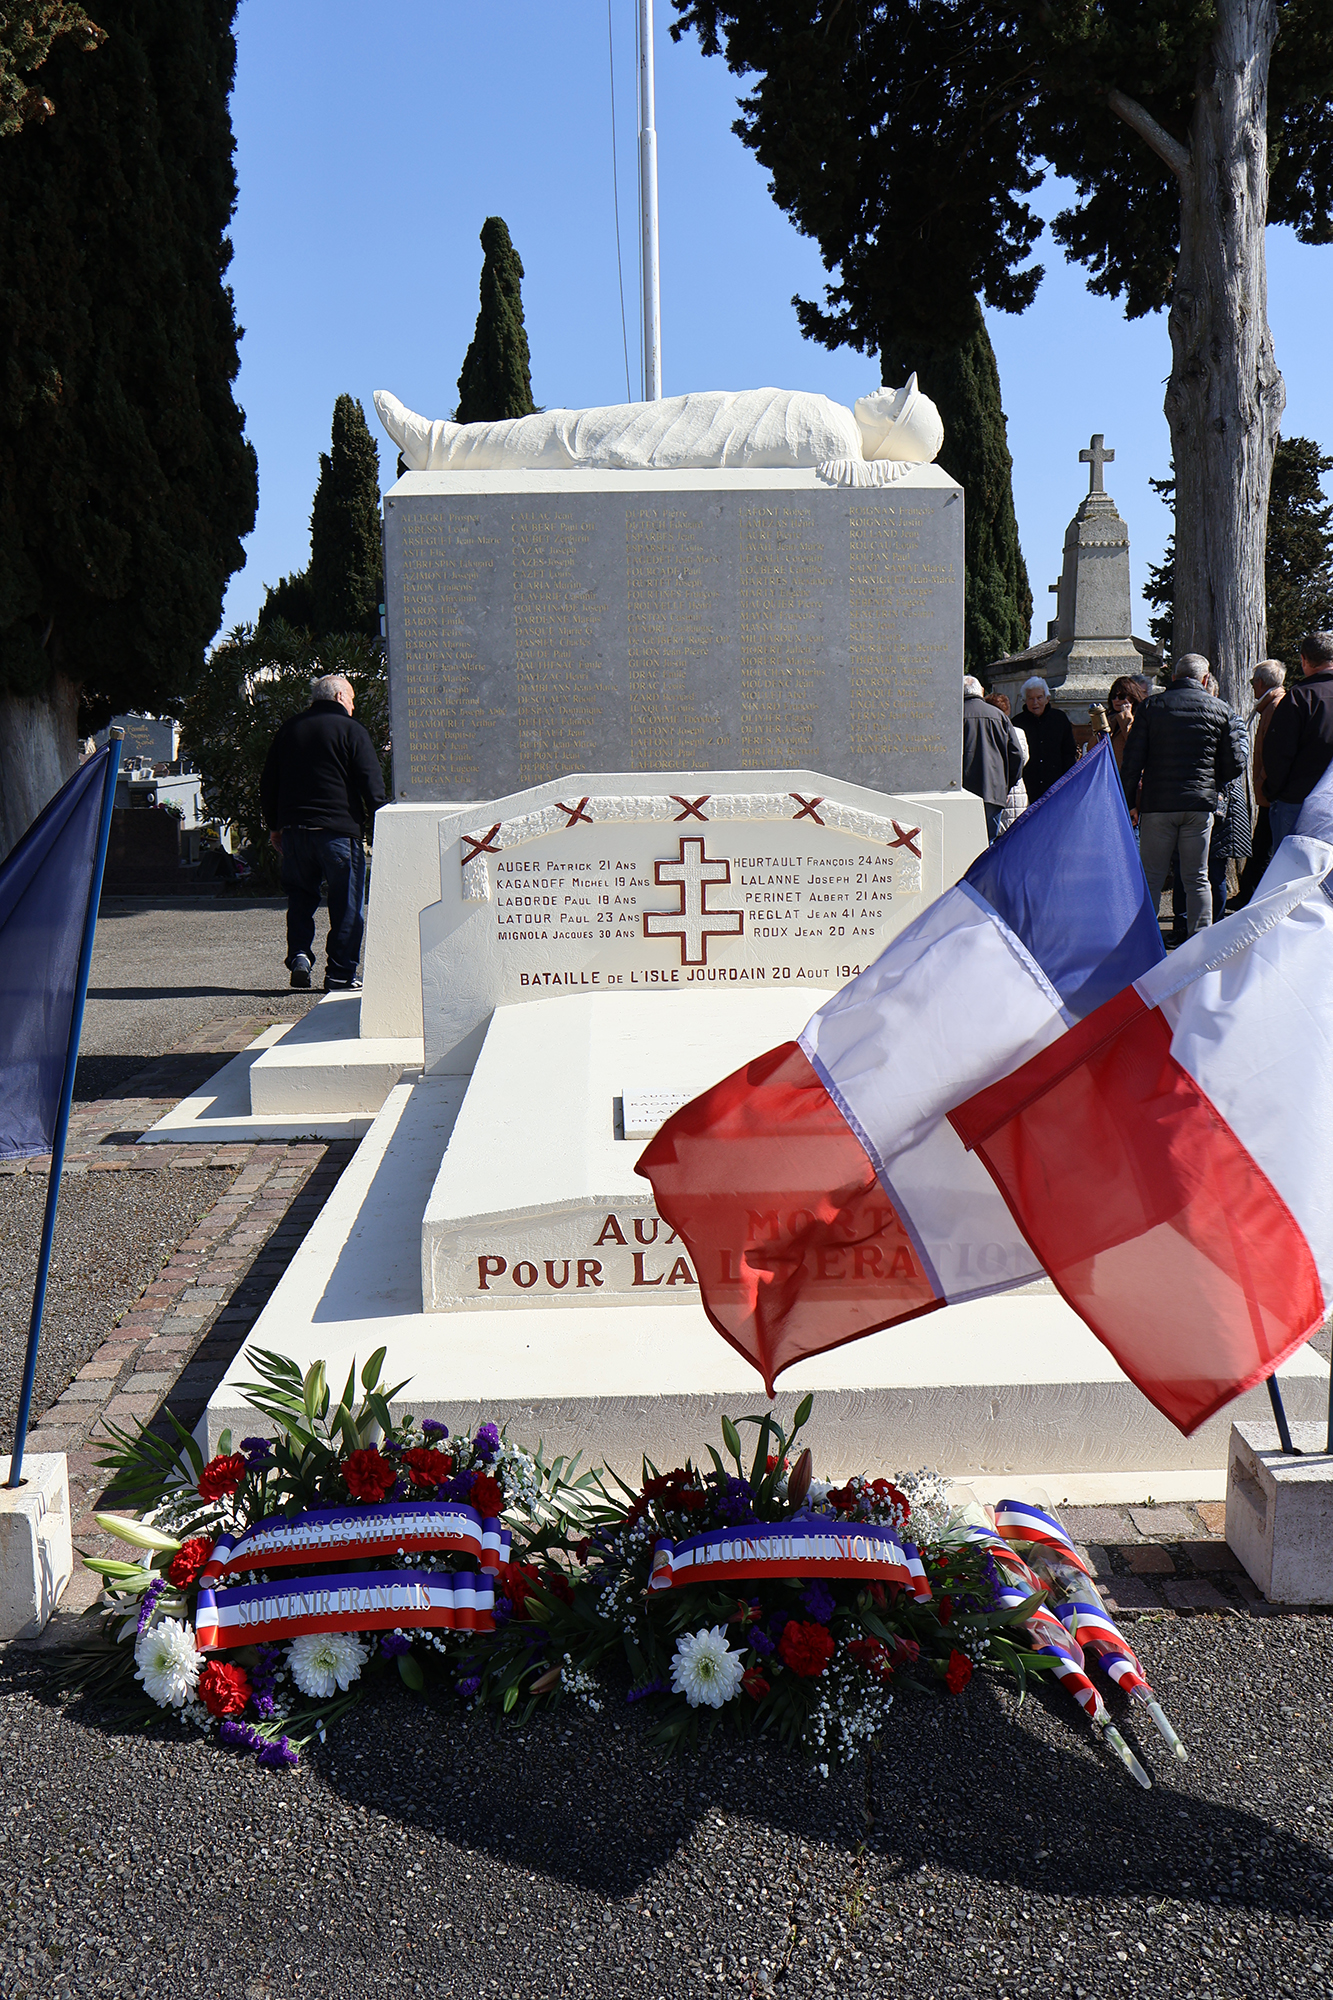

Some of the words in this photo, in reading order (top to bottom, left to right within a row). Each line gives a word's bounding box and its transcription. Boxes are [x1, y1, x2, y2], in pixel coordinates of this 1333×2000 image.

[497, 862, 540, 872] AUGER
[546, 861, 592, 871] PATRICK
[599, 860, 610, 870] 21
[616, 860, 636, 870] ANS
[733, 857, 802, 868] HEURTAULT
[806, 857, 854, 867] FRANÇOIS
[858, 856, 872, 866] 24
[875, 856, 894, 866] ANS
[496, 878, 565, 889] KAGANOFF
[572, 878, 609, 887] MICHEL
[615, 876, 626, 886] 19
[630, 877, 650, 886] ANS
[741, 875, 800, 886] LALANNE
[808, 874, 850, 884] JOSEPH
[856, 874, 868, 884] 21
[872, 874, 892, 884] ANS
[498, 896, 557, 906] LABORDE
[564, 896, 591, 905] PAUL
[598, 895, 609, 904] 18
[614, 895, 636, 904] ANS
[745, 892, 802, 902] PERINET
[809, 892, 850, 902] ALBERT
[856, 890, 868, 900] 21
[871, 891, 892, 900] ANS
[498, 914, 551, 924] LATOUR
[560, 914, 590, 923] PAUL
[596, 912, 613, 923] 23
[618, 913, 640, 922] ANS
[749, 910, 800, 920] REGLAT
[807, 910, 837, 919] JEAN
[842, 909, 854, 918] 41
[860, 908, 882, 918] ANS
[498, 931, 548, 940] MIGNOLA
[553, 930, 594, 939] JACQUES
[599, 930, 611, 938] 30
[616, 929, 635, 938] ANS
[754, 927, 788, 937] ROUX
[795, 927, 823, 937] JEAN
[829, 926, 845, 936] 20
[852, 927, 875, 936] ANS
[520, 971, 600, 986] BATAILLE
[607, 974, 624, 984] DE
[630, 969, 680, 984] L'ISLE
[686, 966, 766, 982] JOURDAIN
[772, 966, 792, 980] 20
[796, 967, 830, 978] AOUT
[592, 1213, 696, 1246] AUX
[478, 1255, 604, 1290] POUR
[631, 1252, 699, 1286] LA
[718, 1241, 1042, 1285] LBERATION
[247, 1520, 324, 1545] ANCIENS
[328, 1511, 468, 1532] COMBATTANTS
[245, 1532, 350, 1559] MEDAILLES
[354, 1526, 464, 1546] MILITAIRES
[692, 1542, 715, 1568] LE
[718, 1534, 800, 1564] CONSEIL
[804, 1534, 902, 1568] MUNICIPAL
[238, 1585, 332, 1628] SOUVENIR
[337, 1583, 432, 1615] FRANCAIS
